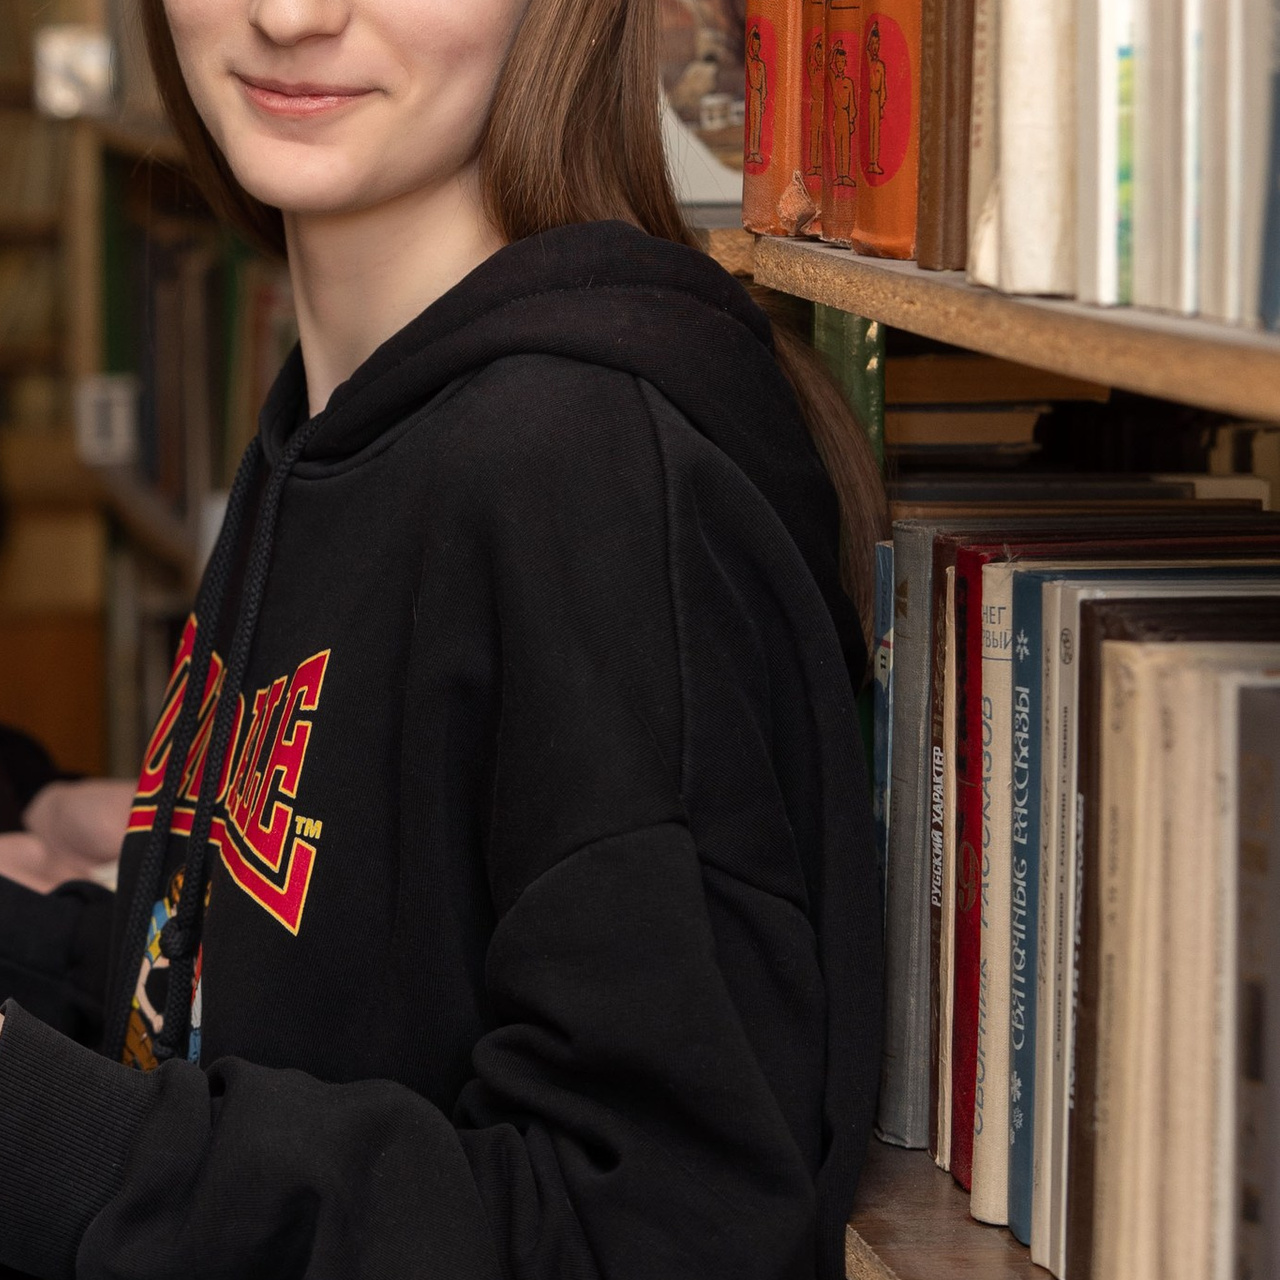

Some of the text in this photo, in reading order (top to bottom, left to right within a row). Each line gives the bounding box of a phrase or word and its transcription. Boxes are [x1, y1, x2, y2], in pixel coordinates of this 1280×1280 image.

[982, 606, 1006, 624] НЕГ
[931, 746, 945, 907] РУССКИЙ ХАРАКТЕР
[1011, 686, 1031, 1051] СВЯТОЧНЫЕ РАССКАЗЫ
